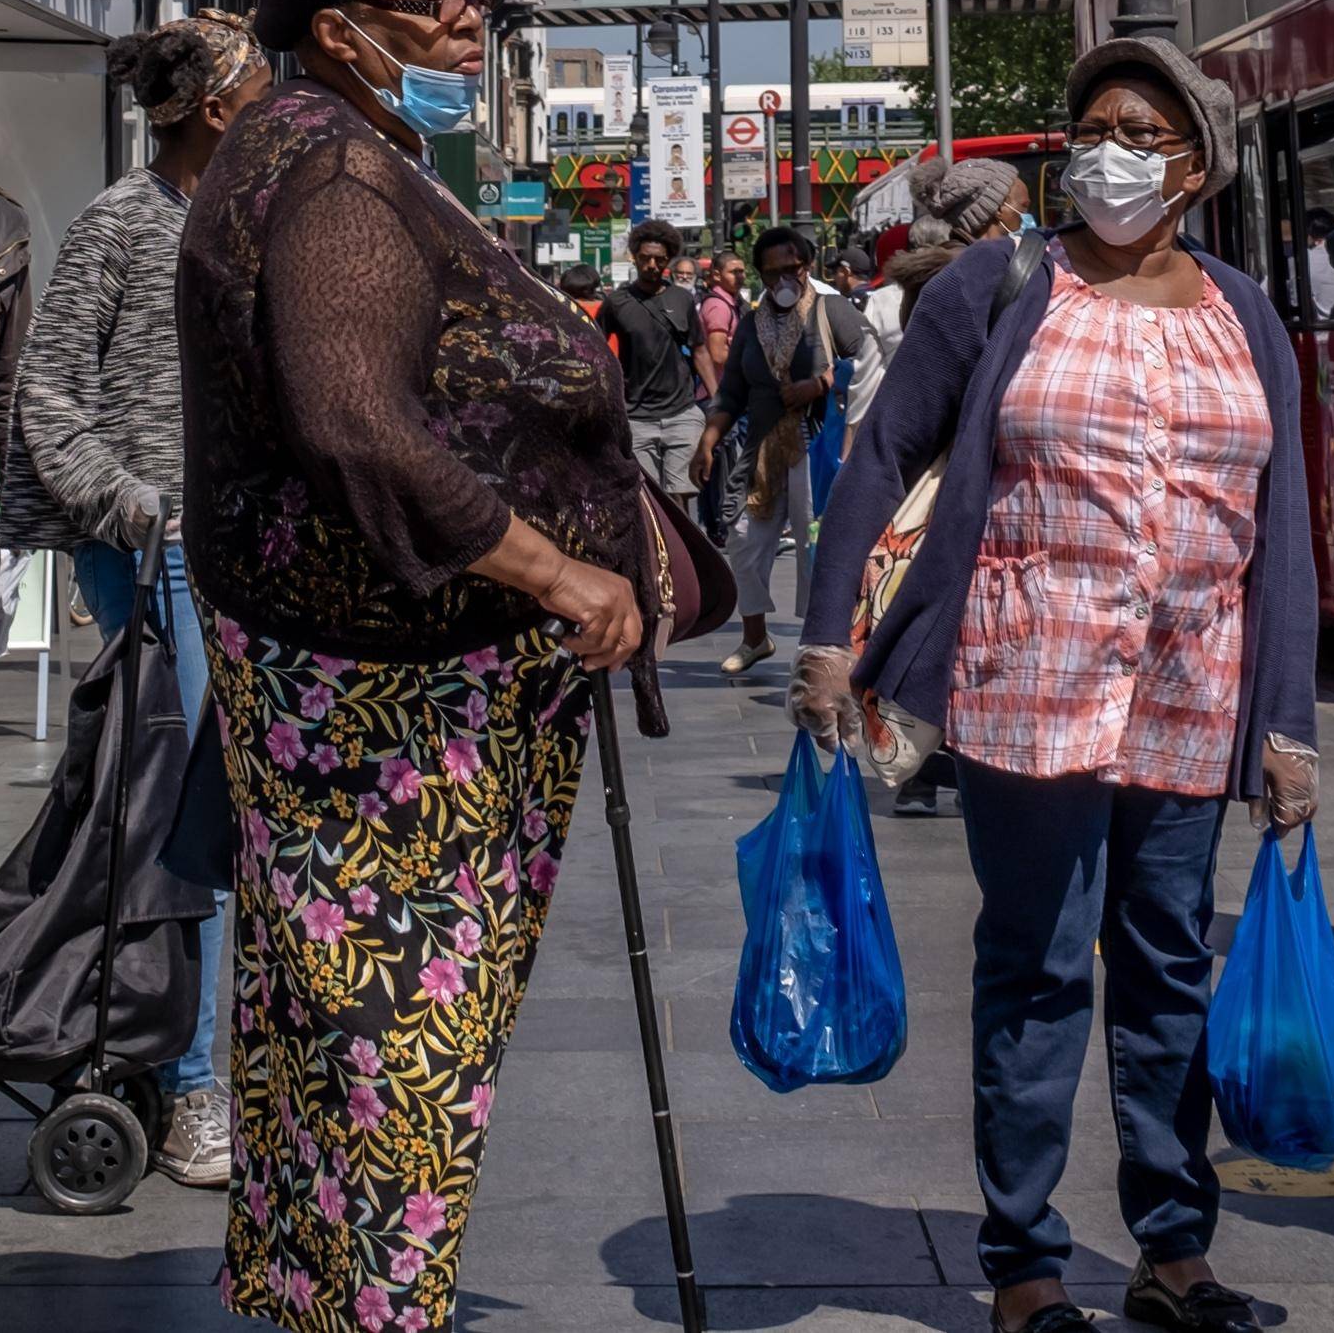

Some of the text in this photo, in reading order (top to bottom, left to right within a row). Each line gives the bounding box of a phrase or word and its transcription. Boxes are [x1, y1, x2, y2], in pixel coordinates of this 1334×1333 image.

[849, 25, 923, 37] 118 133 415
[763, 92, 777, 110] R
